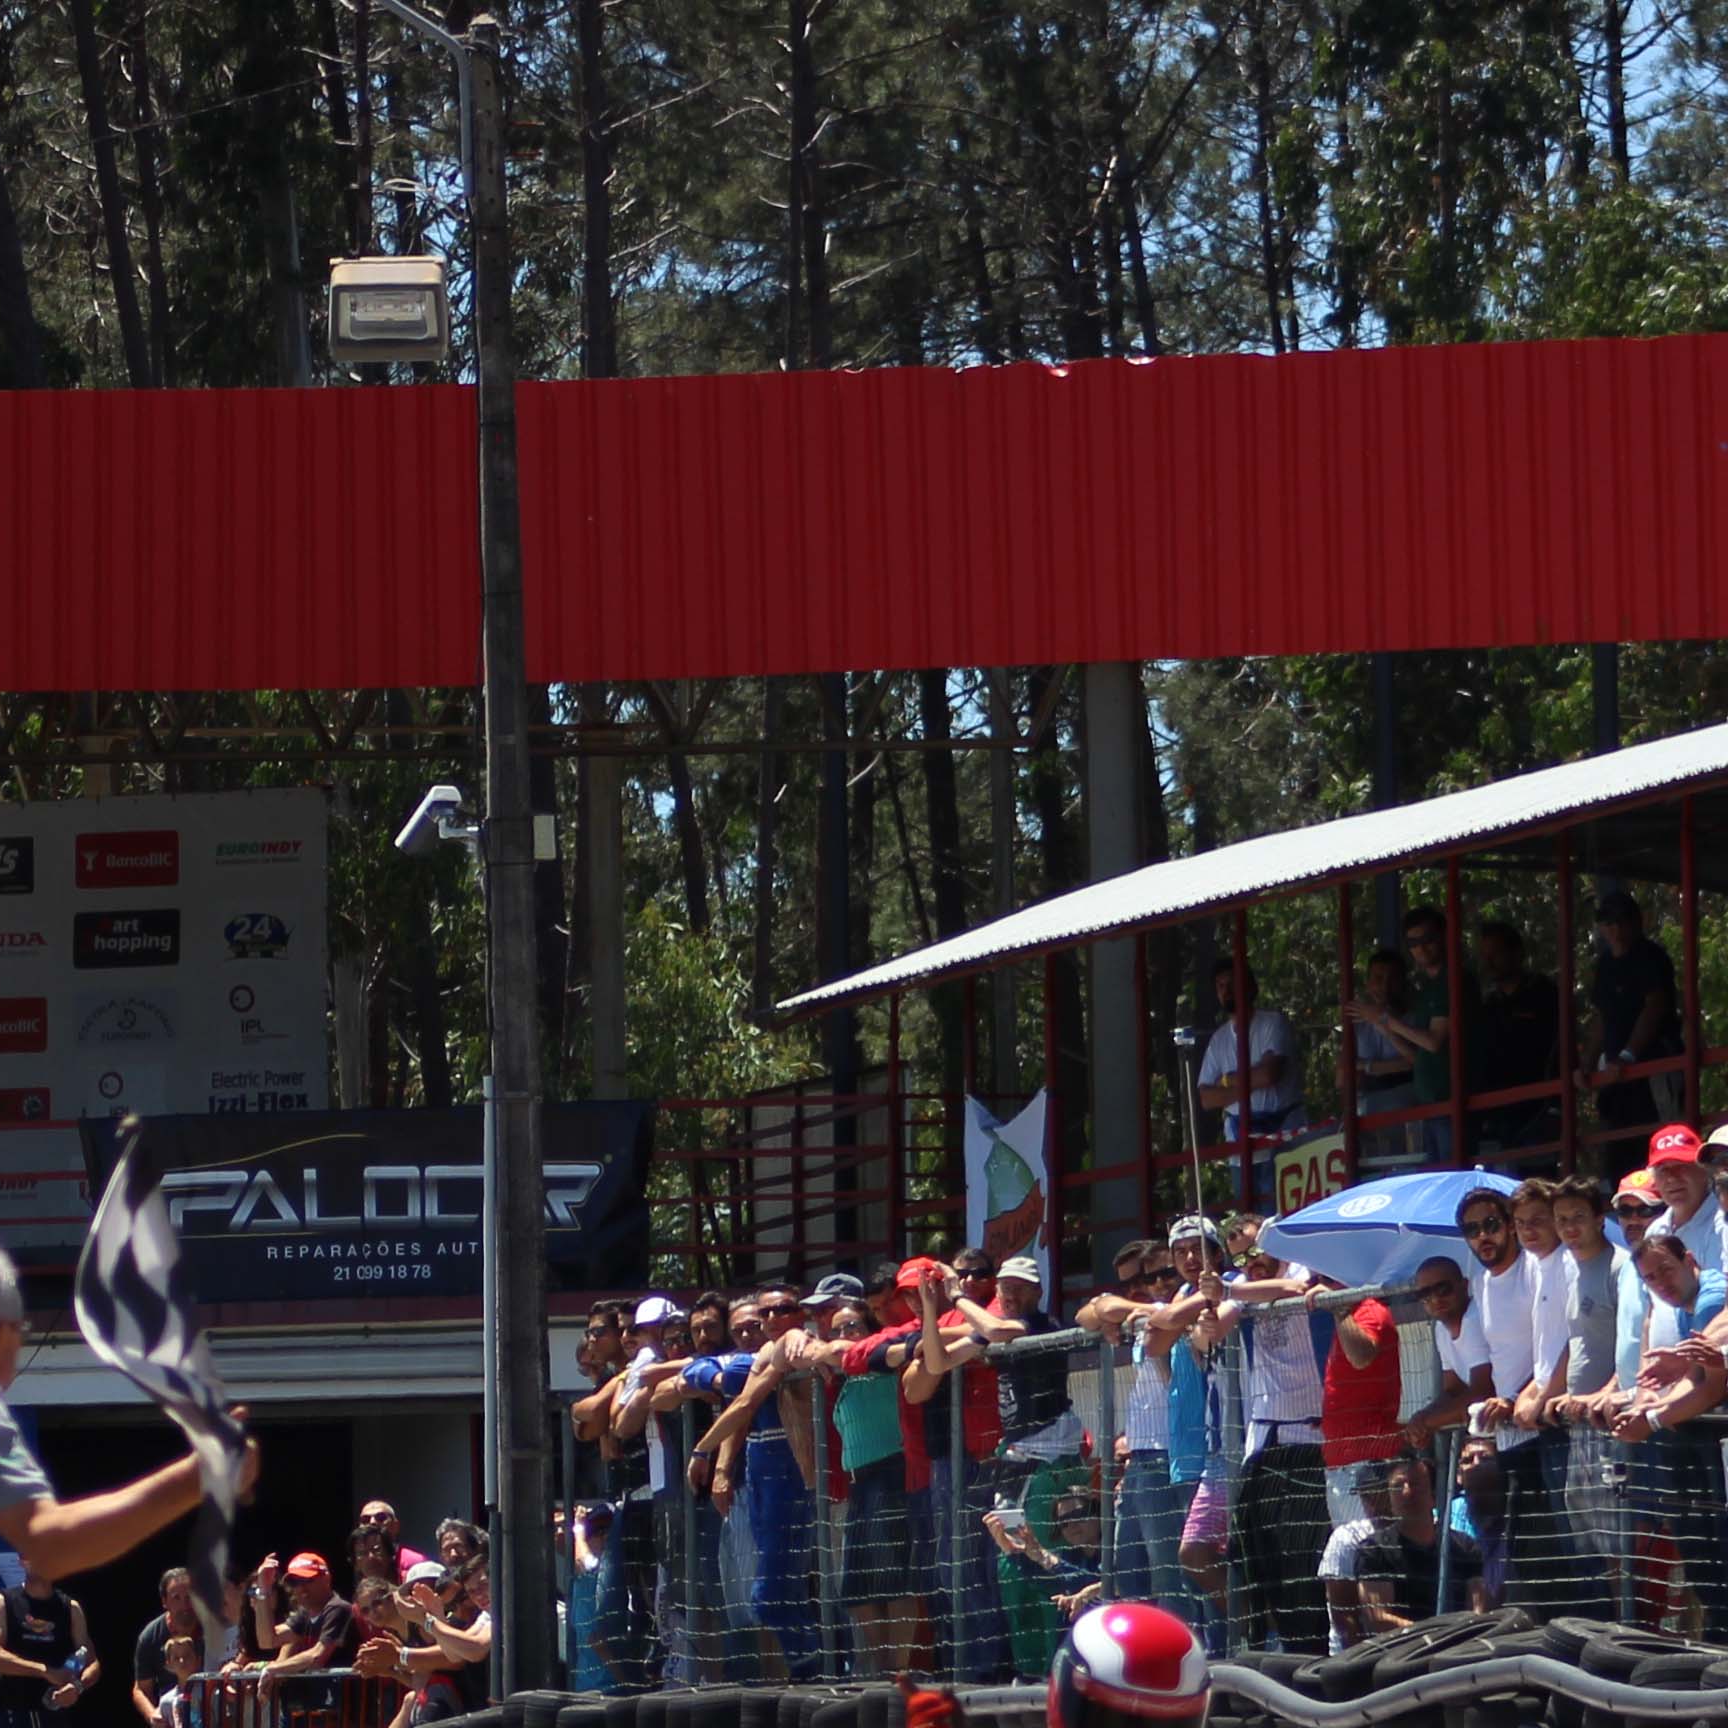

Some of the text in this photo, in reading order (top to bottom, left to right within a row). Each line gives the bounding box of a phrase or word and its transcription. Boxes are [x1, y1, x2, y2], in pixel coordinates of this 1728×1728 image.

[106, 851, 173, 869] BancoBIC
[98, 917, 143, 933] art
[233, 916, 272, 940] 24
[84, 932, 172, 952] hopping
[212, 1071, 306, 1089] Electric Power
[266, 1238, 482, 1262] REPARAÇÕES AUT
[333, 1264, 353, 1280] 21
[388, 1264, 408, 1279] 18
[411, 1263, 432, 1279] 78
